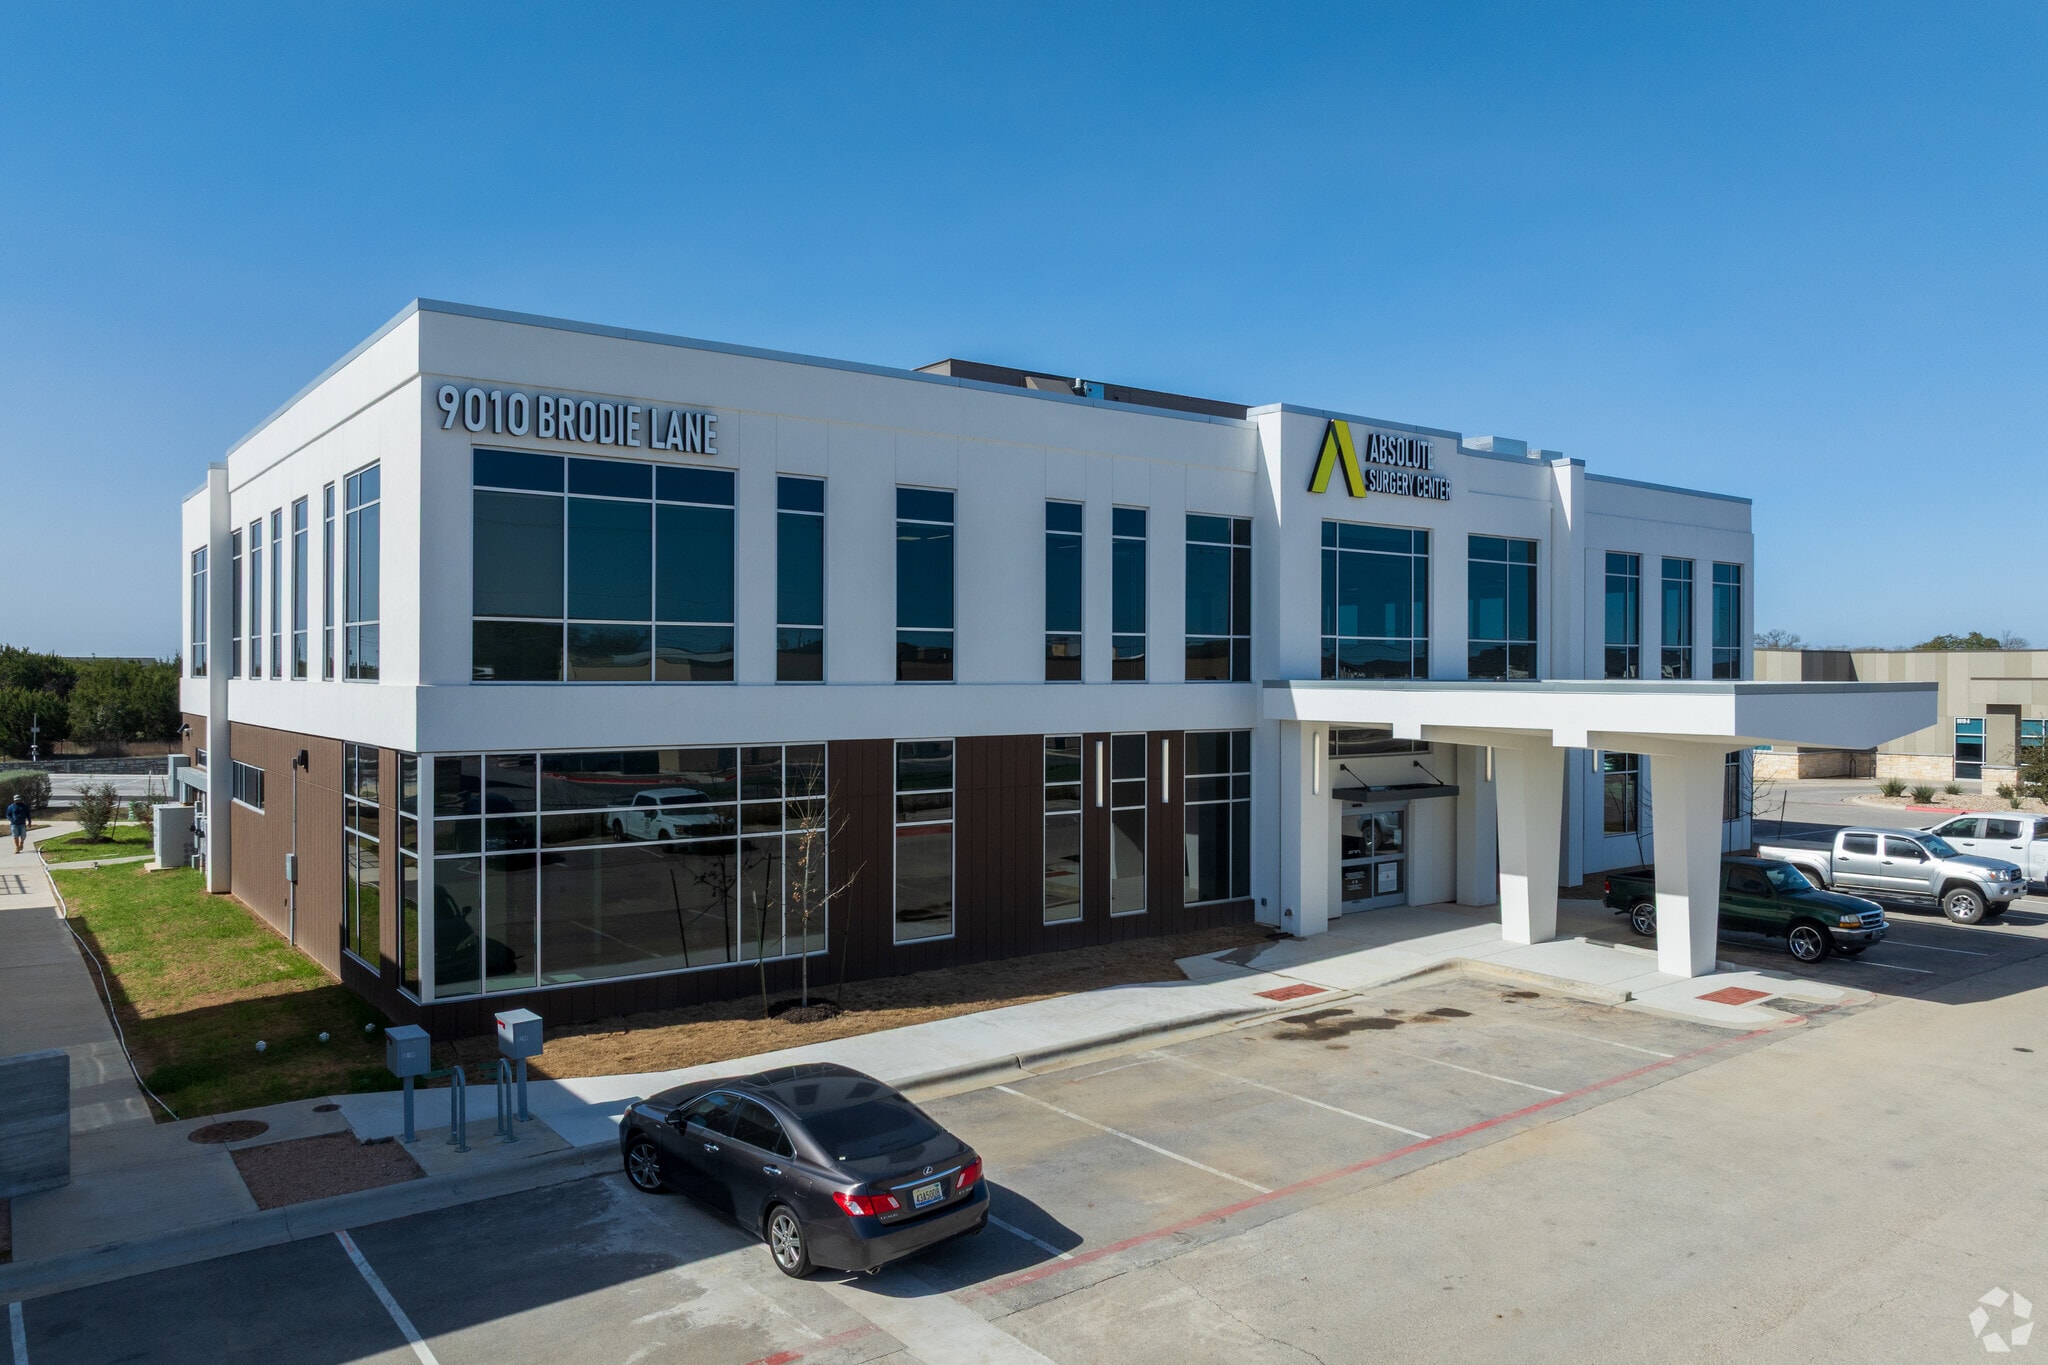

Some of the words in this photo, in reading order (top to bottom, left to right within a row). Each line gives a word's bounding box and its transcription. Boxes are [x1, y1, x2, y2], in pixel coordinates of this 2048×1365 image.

[438, 384, 530, 436] 9010
[537, 395, 641, 447] BRODIE
[650, 408, 718, 455] LANE
[1367, 433, 1434, 470] ABSOLUTE
[1367, 469, 1414, 496] SURGERY
[1415, 475, 1451, 500] CENTER
